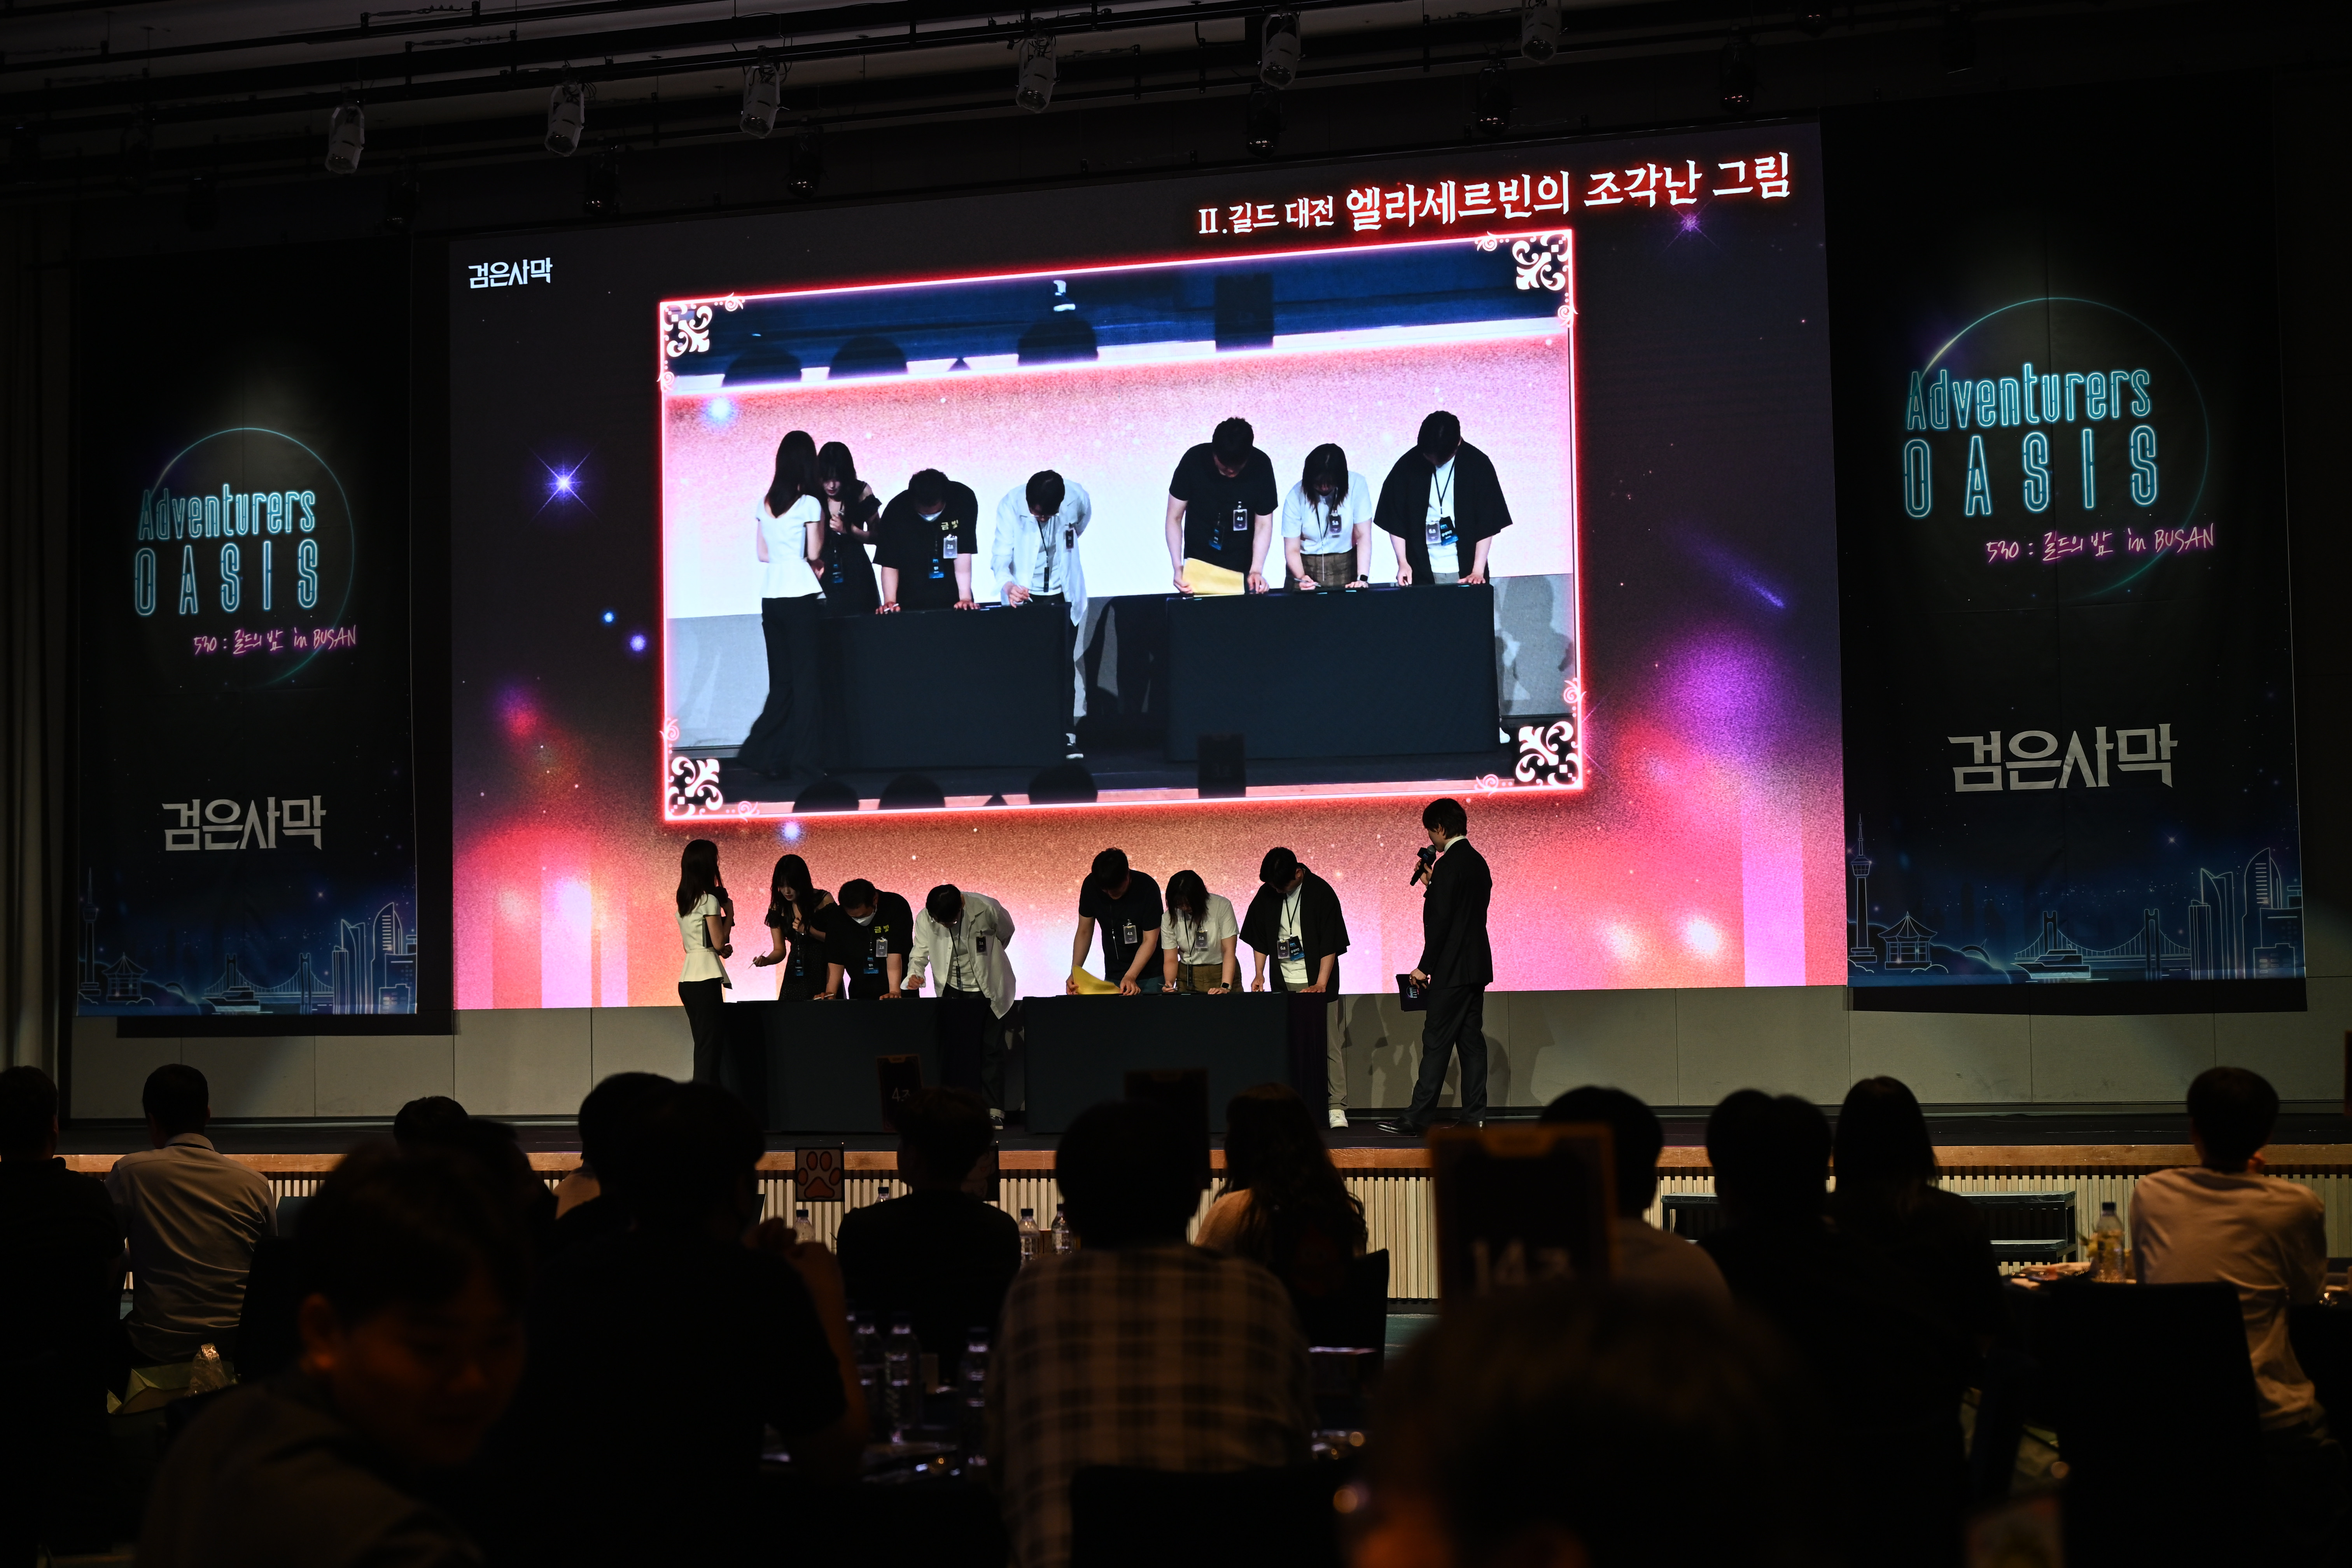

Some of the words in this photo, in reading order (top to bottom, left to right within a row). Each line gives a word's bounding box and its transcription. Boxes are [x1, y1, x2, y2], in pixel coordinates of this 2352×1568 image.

[1285, 195, 1334, 228] 대전
[1346, 170, 1572, 232] 엘라세르빈의
[1584, 159, 1703, 208] 조각난
[1712, 152, 1790, 199] 그림
[468, 257, 553, 289] 검은사막
[1906, 362, 2151, 430] Adventurers
[1904, 425, 2157, 518] OASIS
[138, 483, 316, 541] Adventurers
[2042, 530, 2083, 561] 길드의
[2091, 532, 2113, 556] 밤
[2154, 523, 2214, 553] BUSAN
[134, 539, 318, 616] OASIS
[233, 629, 262, 655] 길드의
[267, 630, 283, 652] 밤
[313, 624, 357, 649] BUSAN
[1947, 723, 2179, 793] 검은사막
[162, 795, 327, 851] 검은사막
